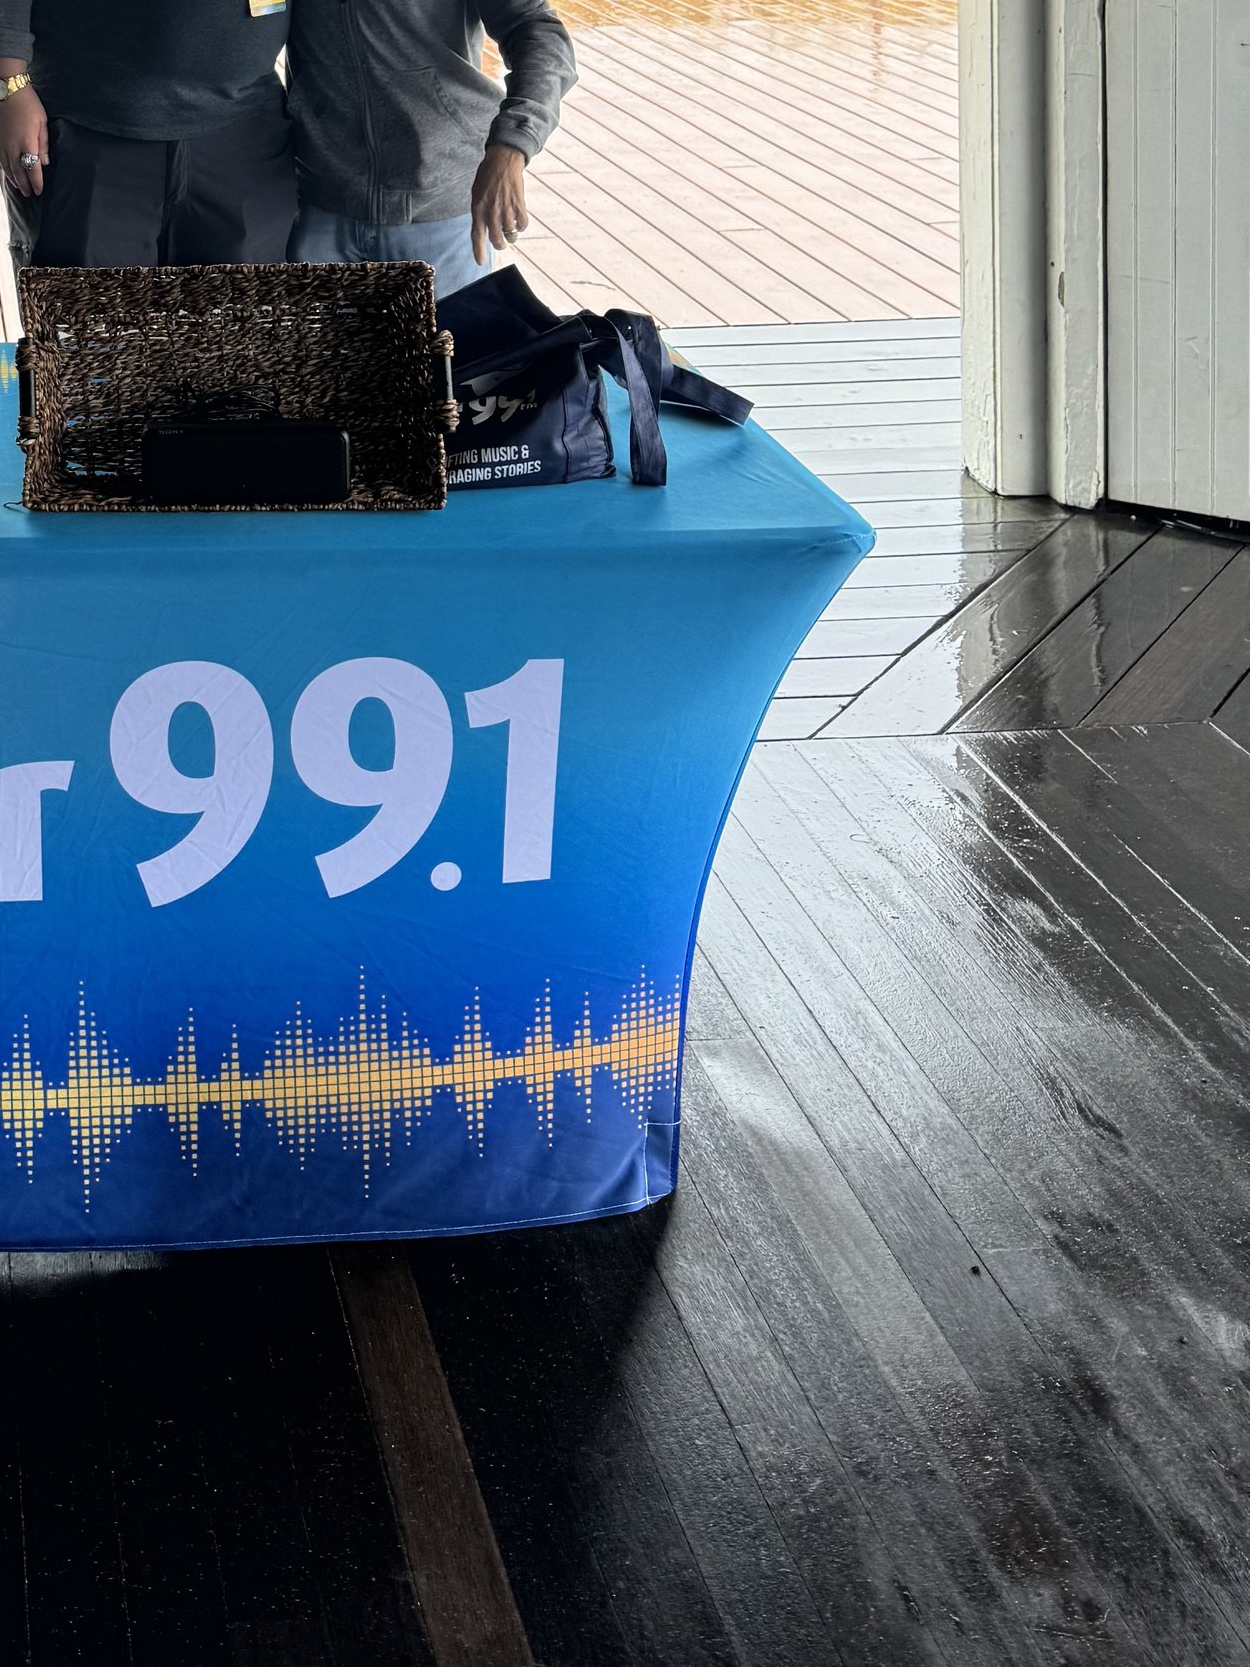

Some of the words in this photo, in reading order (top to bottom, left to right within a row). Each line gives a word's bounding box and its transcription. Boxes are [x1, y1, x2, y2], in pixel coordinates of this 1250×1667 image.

[481, 445, 518, 463] MUSIC
[521, 444, 530, 459] &
[494, 460, 542, 479] STORIES
[109, 656, 564, 908] 99.1
